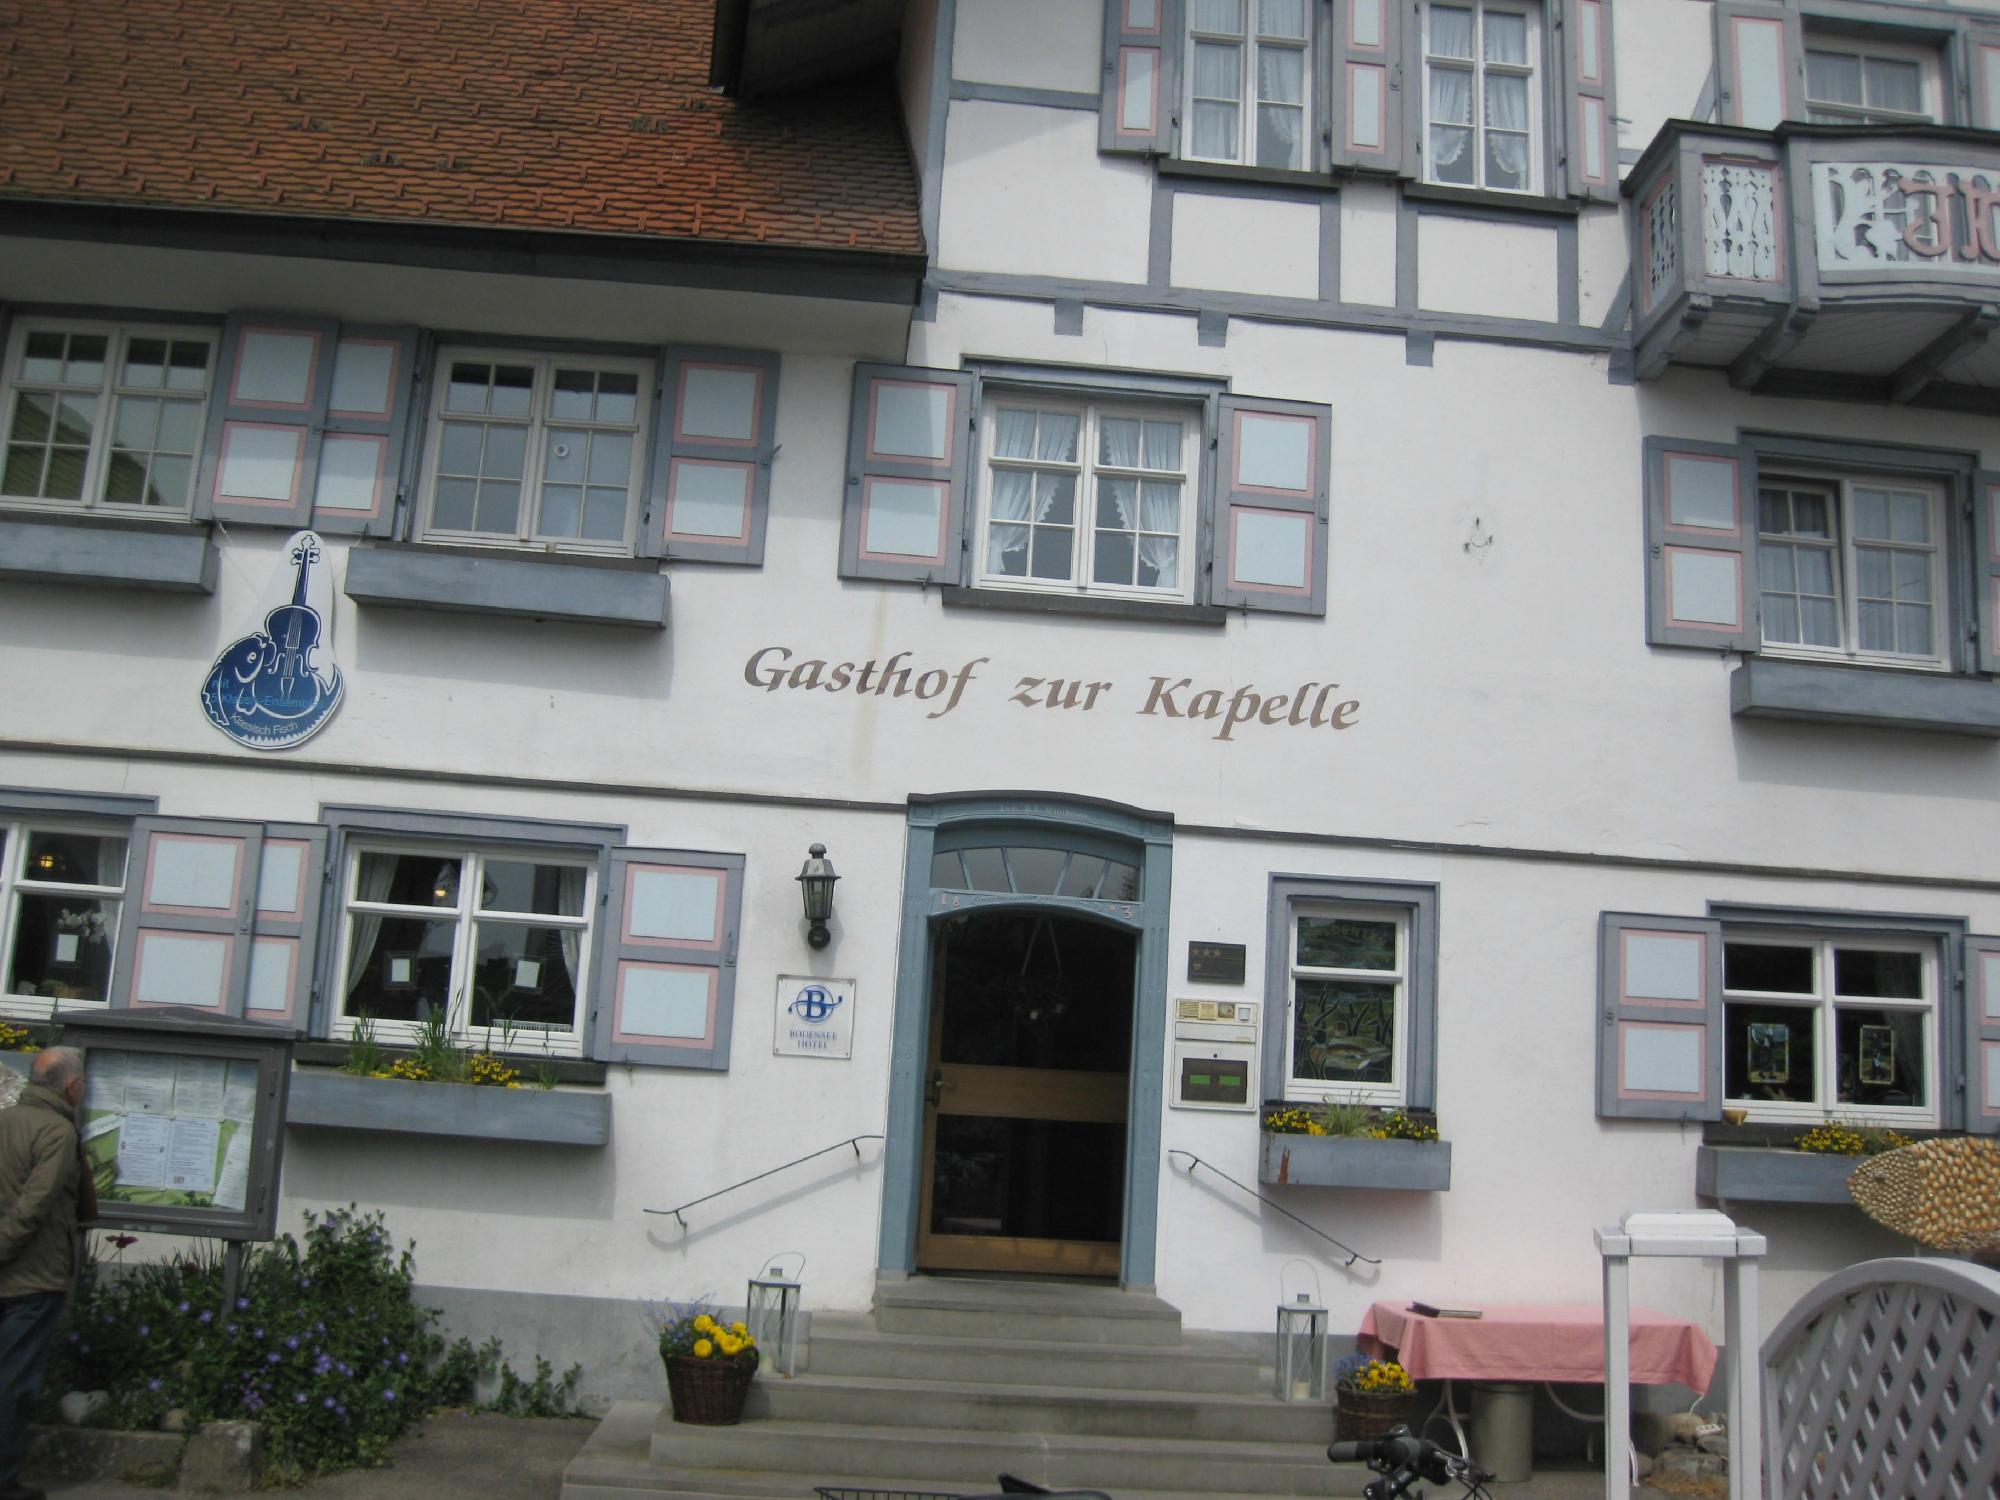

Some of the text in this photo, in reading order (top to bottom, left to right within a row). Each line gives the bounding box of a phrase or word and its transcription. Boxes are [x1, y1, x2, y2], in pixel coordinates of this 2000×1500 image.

[744, 646, 1360, 741] Gasthof zur Kapelle
[273, 722, 299, 735] Fisch
